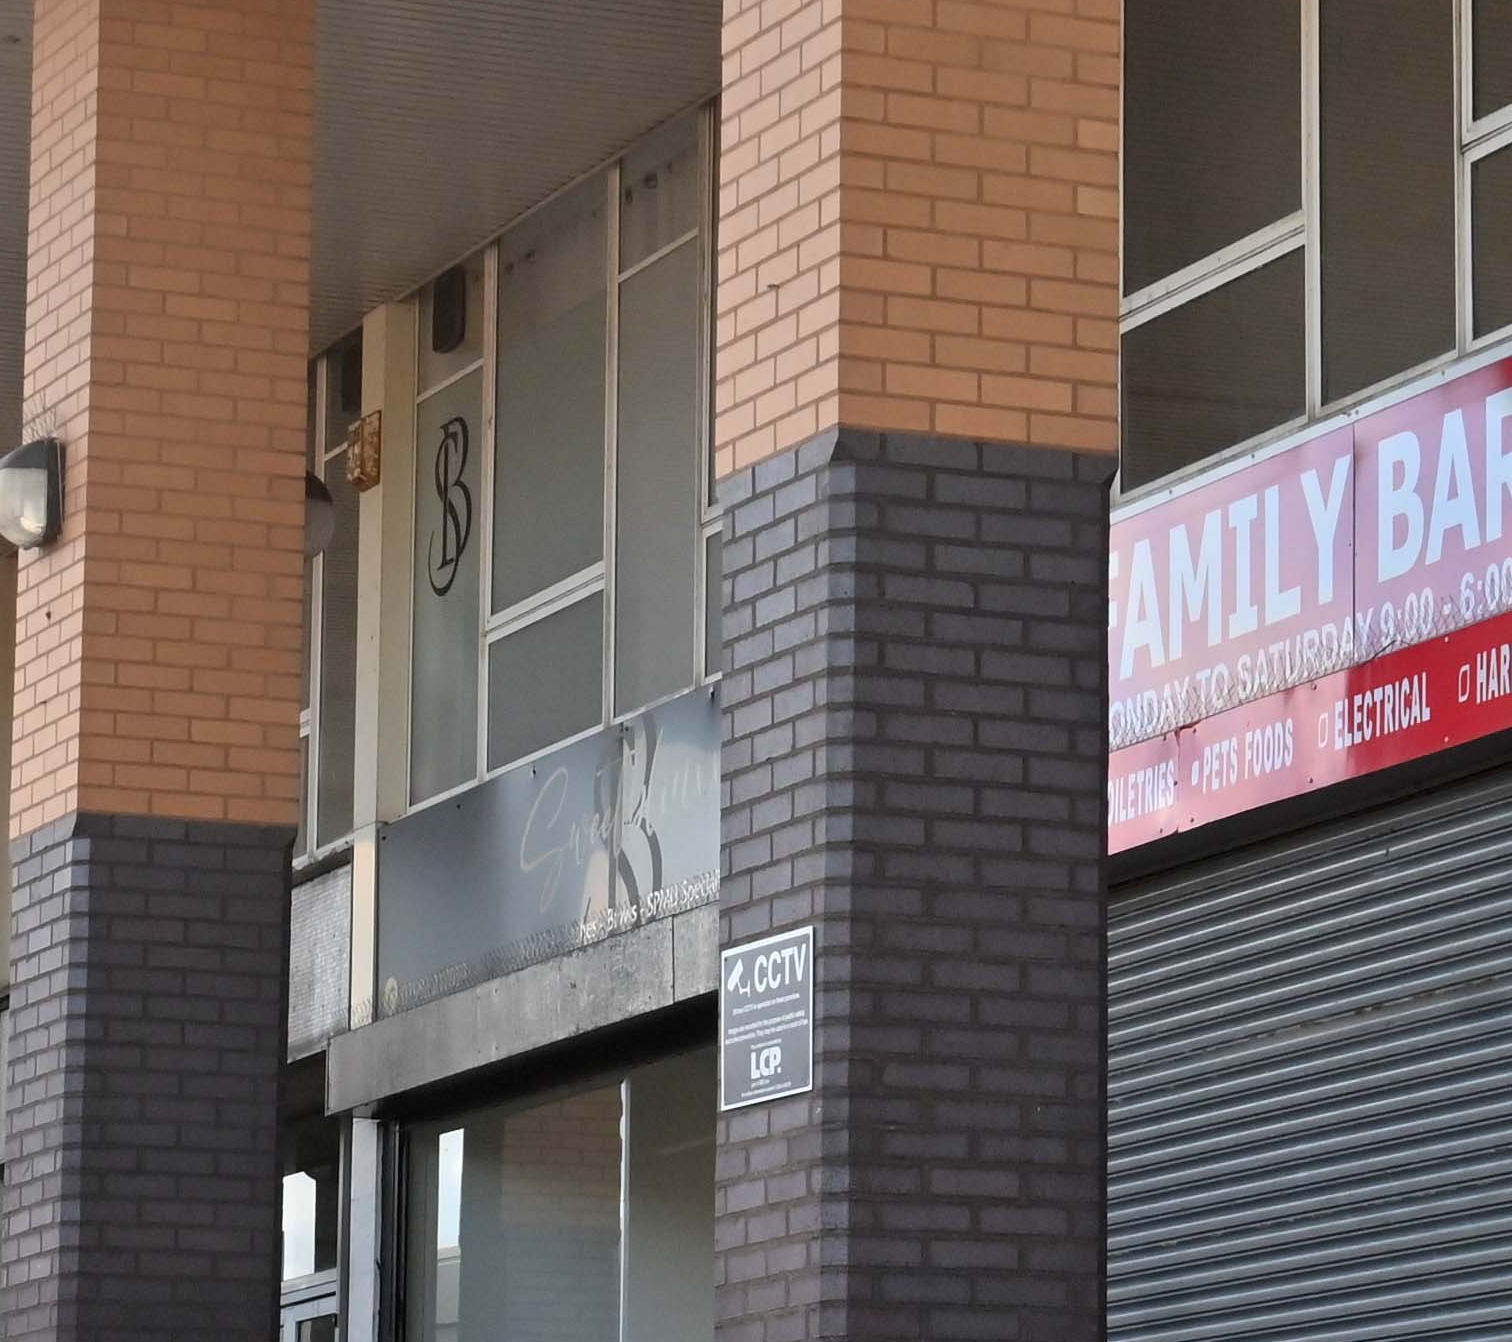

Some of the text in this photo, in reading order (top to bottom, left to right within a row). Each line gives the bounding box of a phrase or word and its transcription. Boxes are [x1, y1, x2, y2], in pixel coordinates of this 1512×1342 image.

[1109, 676, 1191, 744] ONDAY
[1196, 662, 1230, 719] TO
[1238, 607, 1374, 701] SATURDAY
[1379, 587, 1434, 648] 9:00
[1334, 672, 1432, 750] ELECTRICAL
[1108, 759, 1175, 827] OILETRIES
[1202, 718, 1294, 794] PETS FOODS
[754, 943, 807, 993] CCTV
